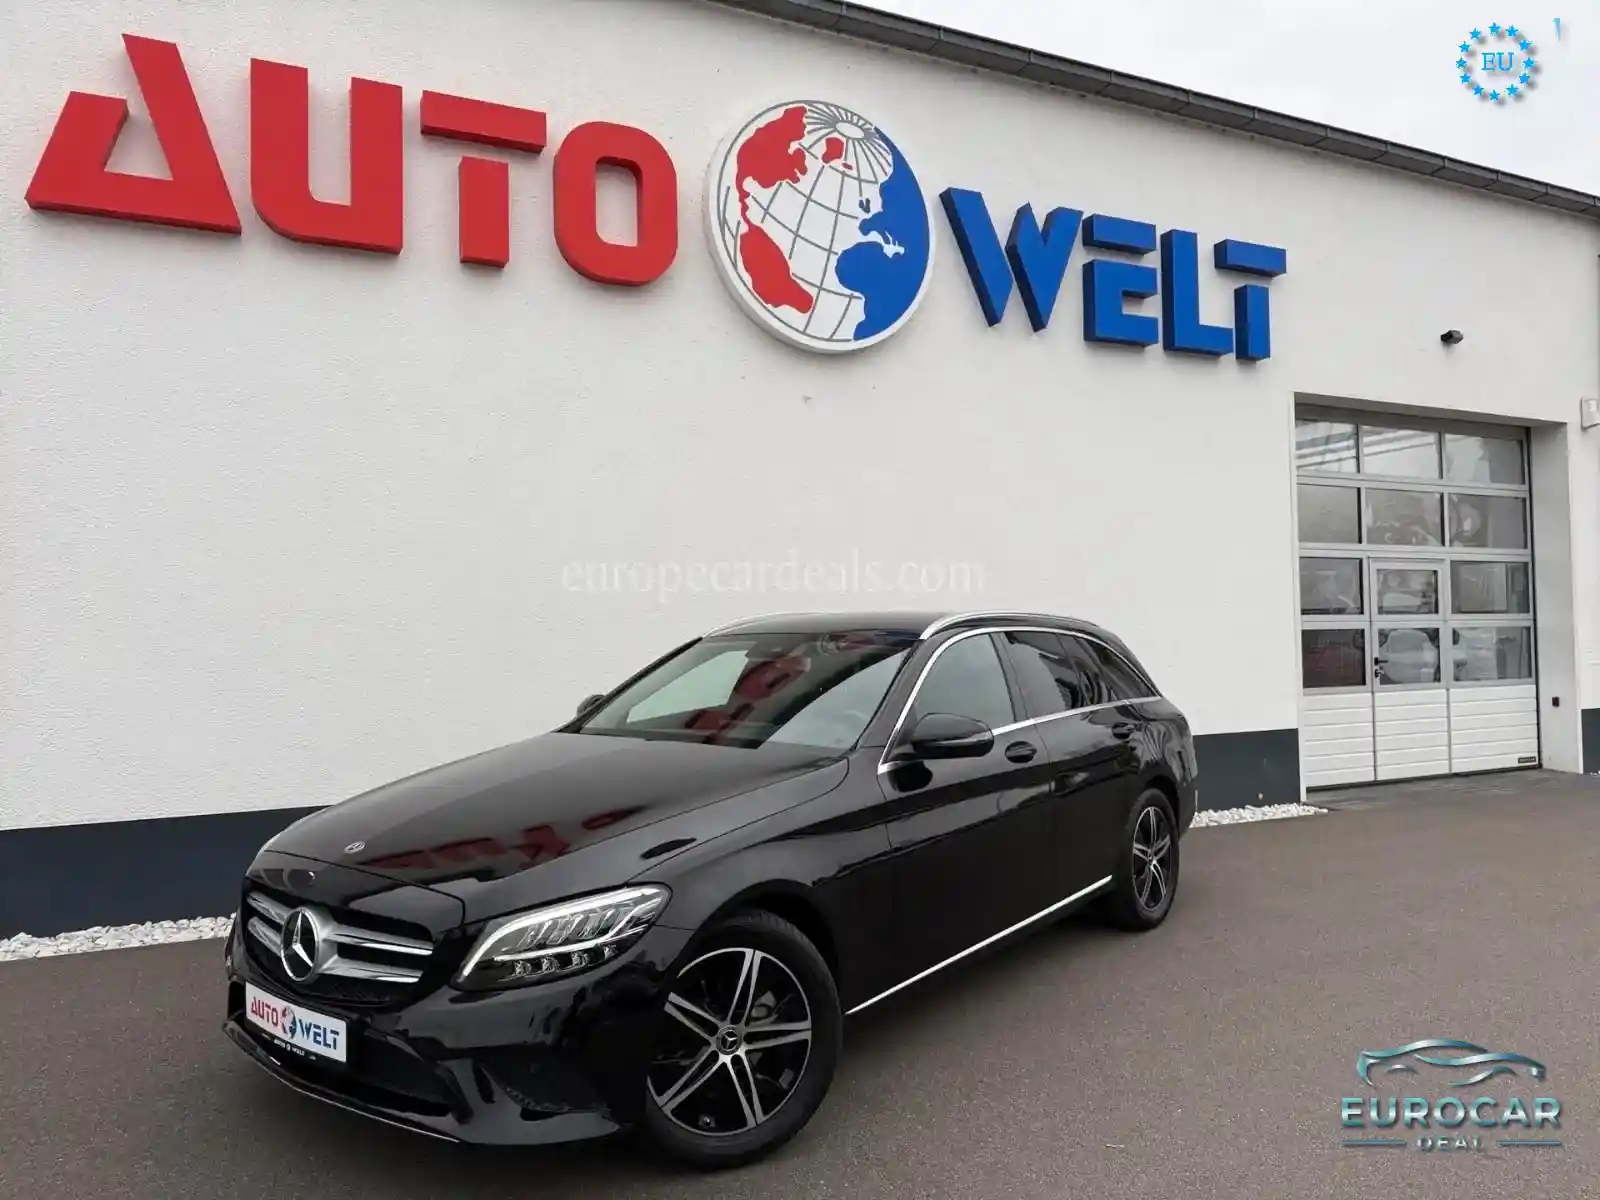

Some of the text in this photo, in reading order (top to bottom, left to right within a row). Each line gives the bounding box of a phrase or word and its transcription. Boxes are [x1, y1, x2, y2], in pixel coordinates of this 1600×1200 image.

[24, 33, 1287, 362] AUTO WELT
[250, 996, 279, 1027] AUTO
[298, 1018, 340, 1050] WELT
